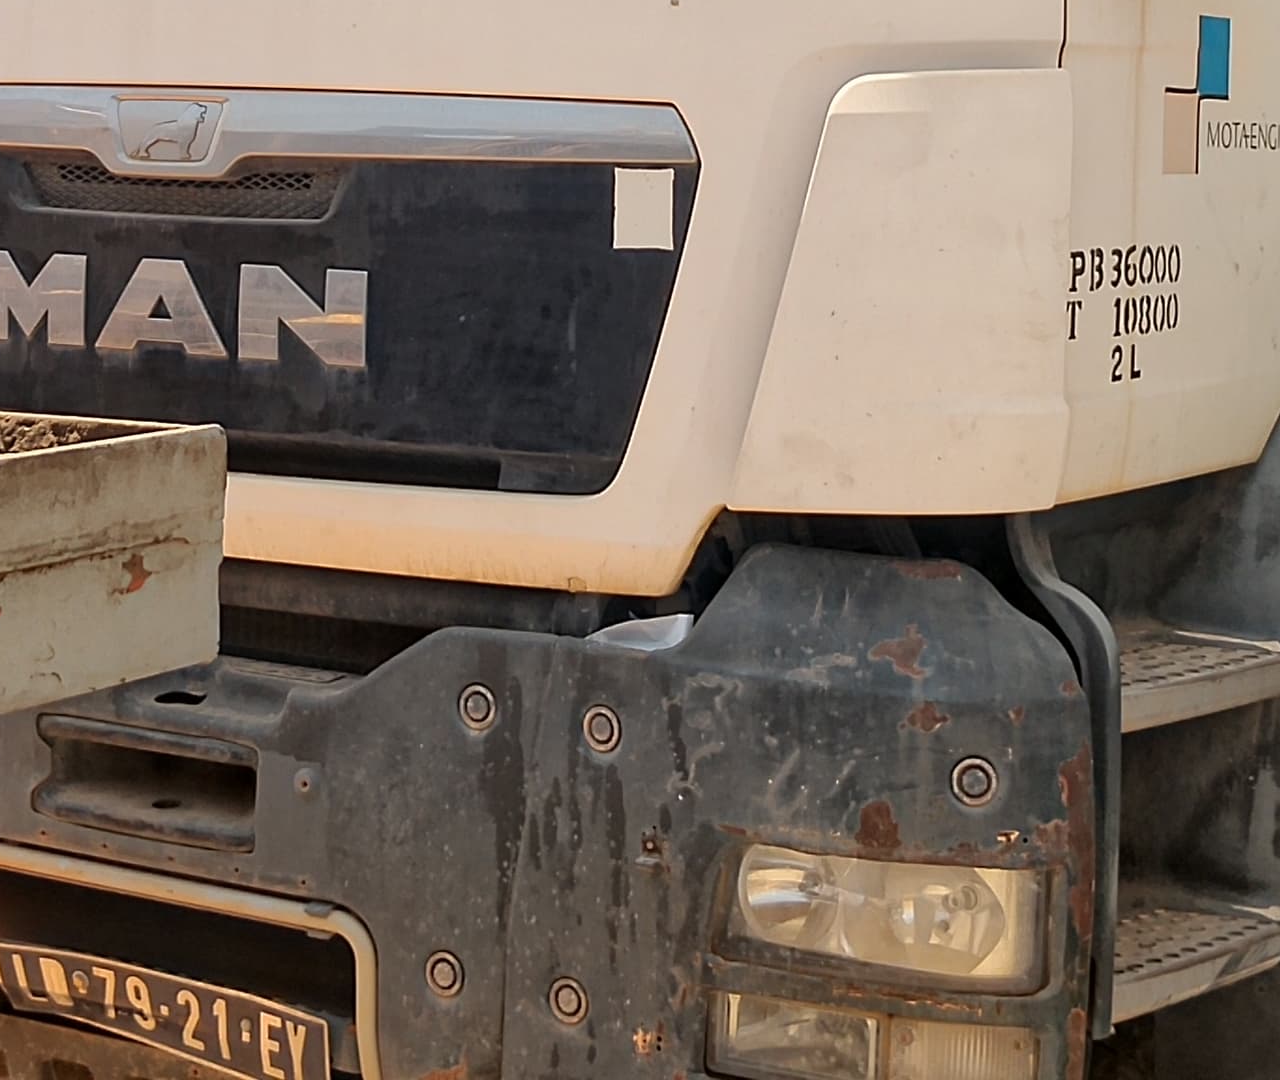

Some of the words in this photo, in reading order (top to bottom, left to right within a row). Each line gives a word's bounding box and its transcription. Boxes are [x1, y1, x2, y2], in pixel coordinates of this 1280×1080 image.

[1068, 247, 1104, 293] PB
[1110, 244, 1181, 289] 36000
[1066, 300, 1083, 340] T
[1113, 293, 1179, 338] 10800
